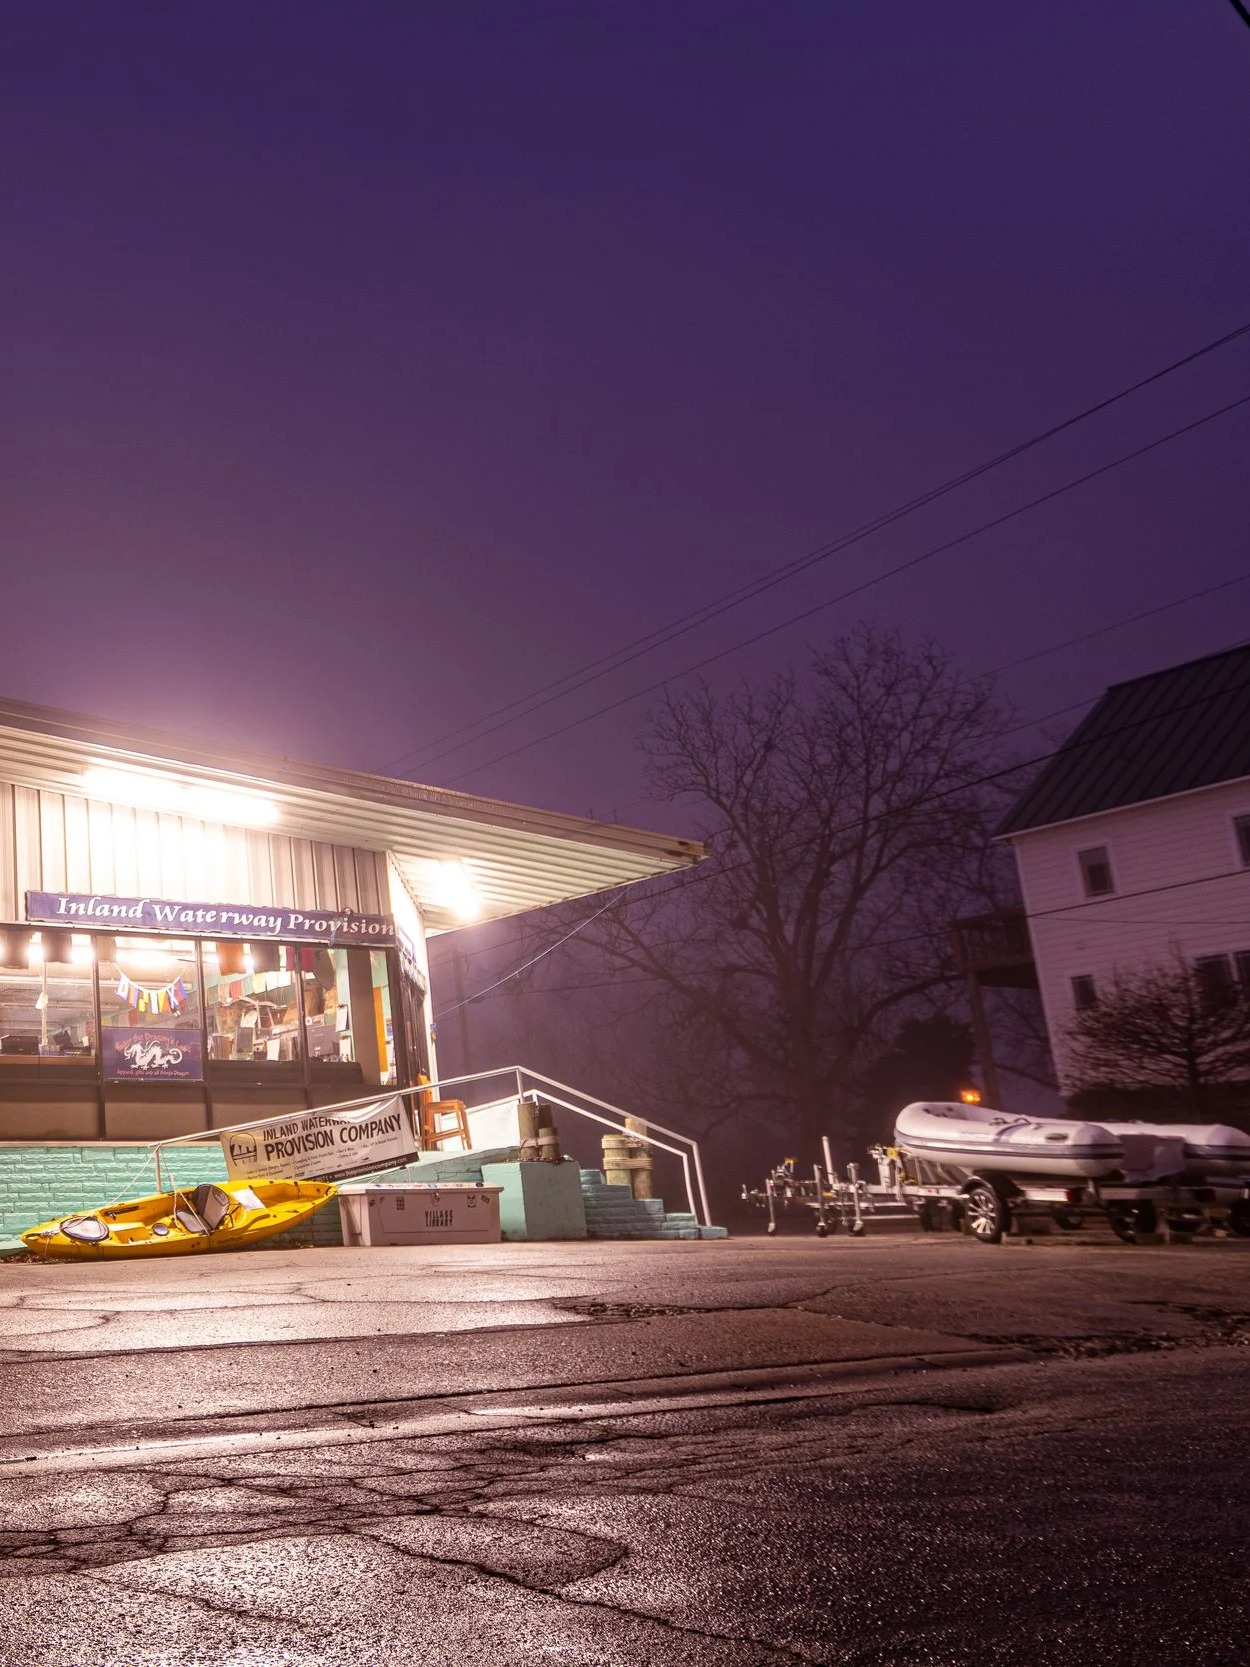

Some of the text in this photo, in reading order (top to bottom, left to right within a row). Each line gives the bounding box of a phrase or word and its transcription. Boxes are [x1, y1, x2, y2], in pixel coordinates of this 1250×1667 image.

[56, 897, 396, 937] Inland Waterway Provision
[263, 1116, 351, 1142] INLAND WATERW
[264, 1130, 335, 1162] PROVISION
[339, 1113, 402, 1145] COMPANY
[424, 1209, 454, 1219] VILLAGE
[425, 1217, 454, 1228] LIBRARY
